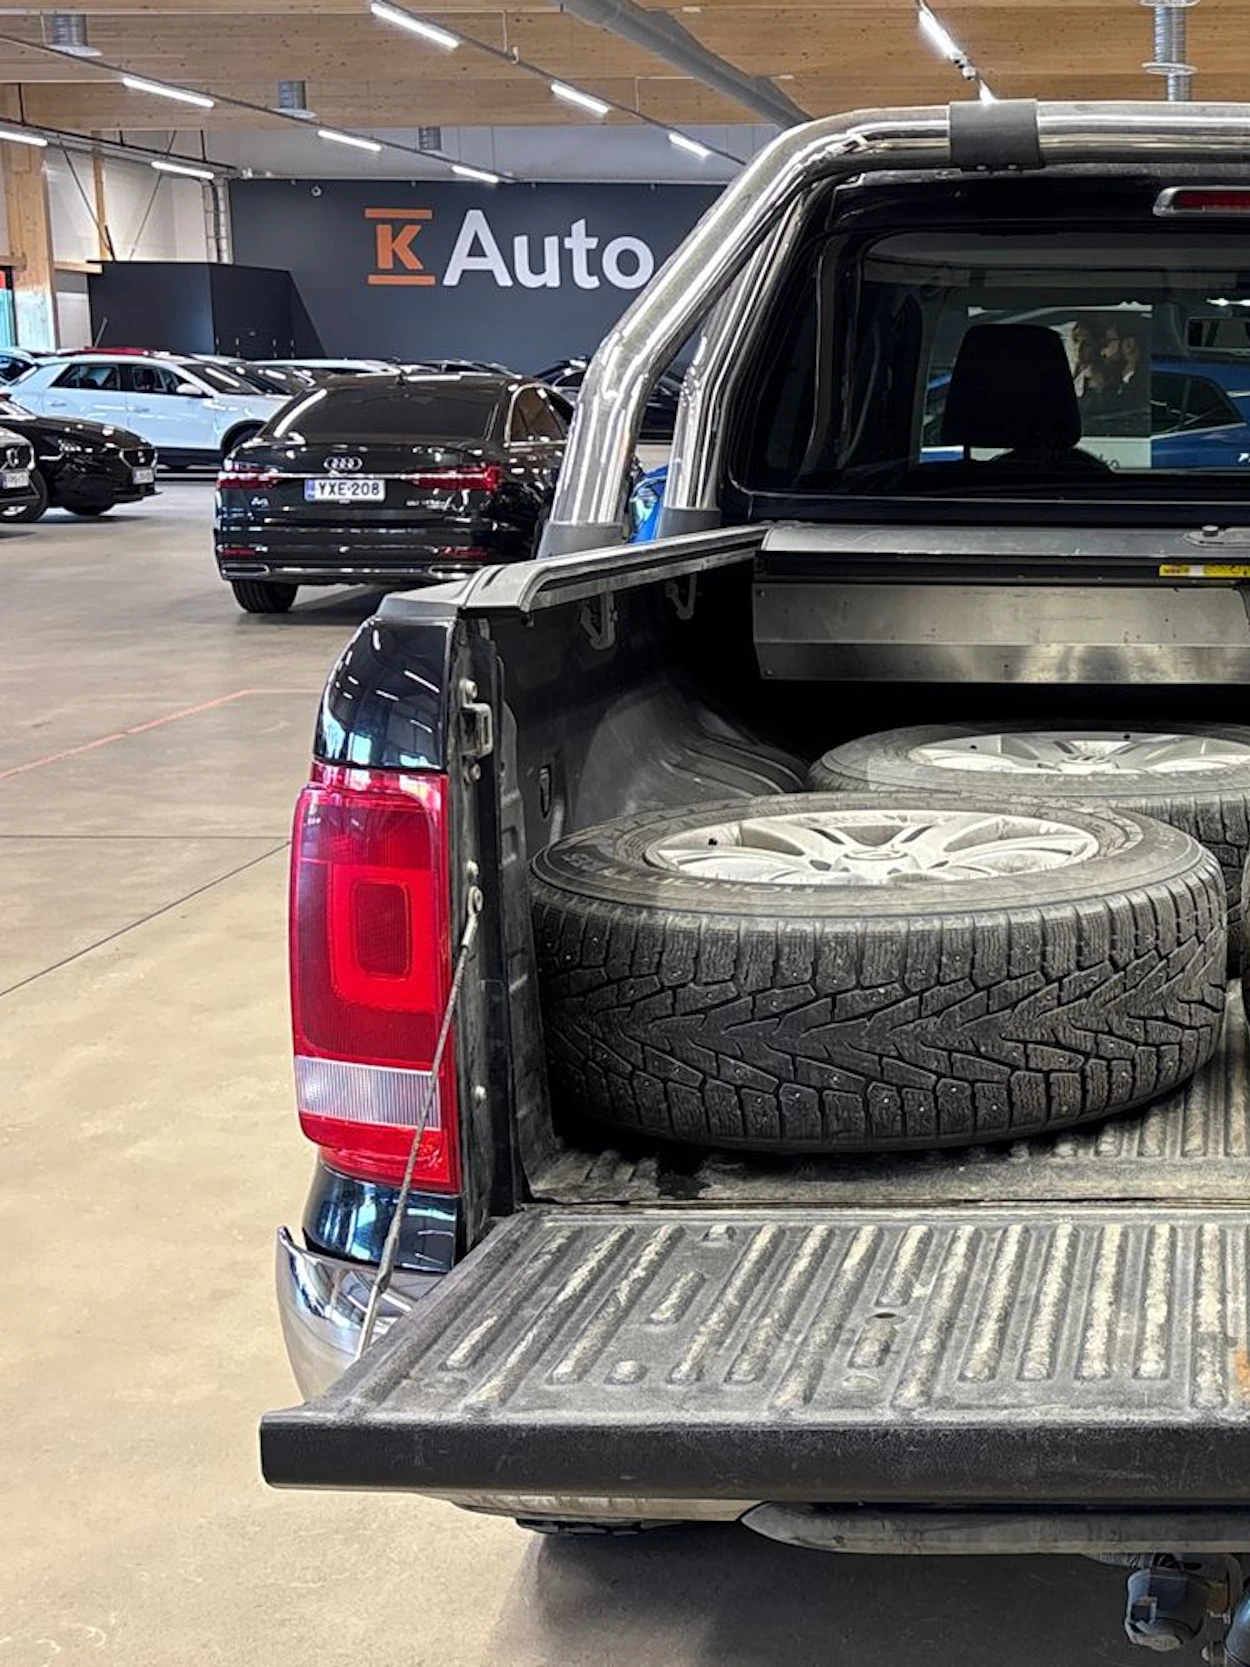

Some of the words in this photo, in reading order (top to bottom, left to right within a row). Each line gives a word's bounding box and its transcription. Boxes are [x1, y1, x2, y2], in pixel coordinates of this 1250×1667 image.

[376, 224, 424, 270] K
[442, 209, 655, 290] Auto
[318, 482, 381, 497] YXE-208
